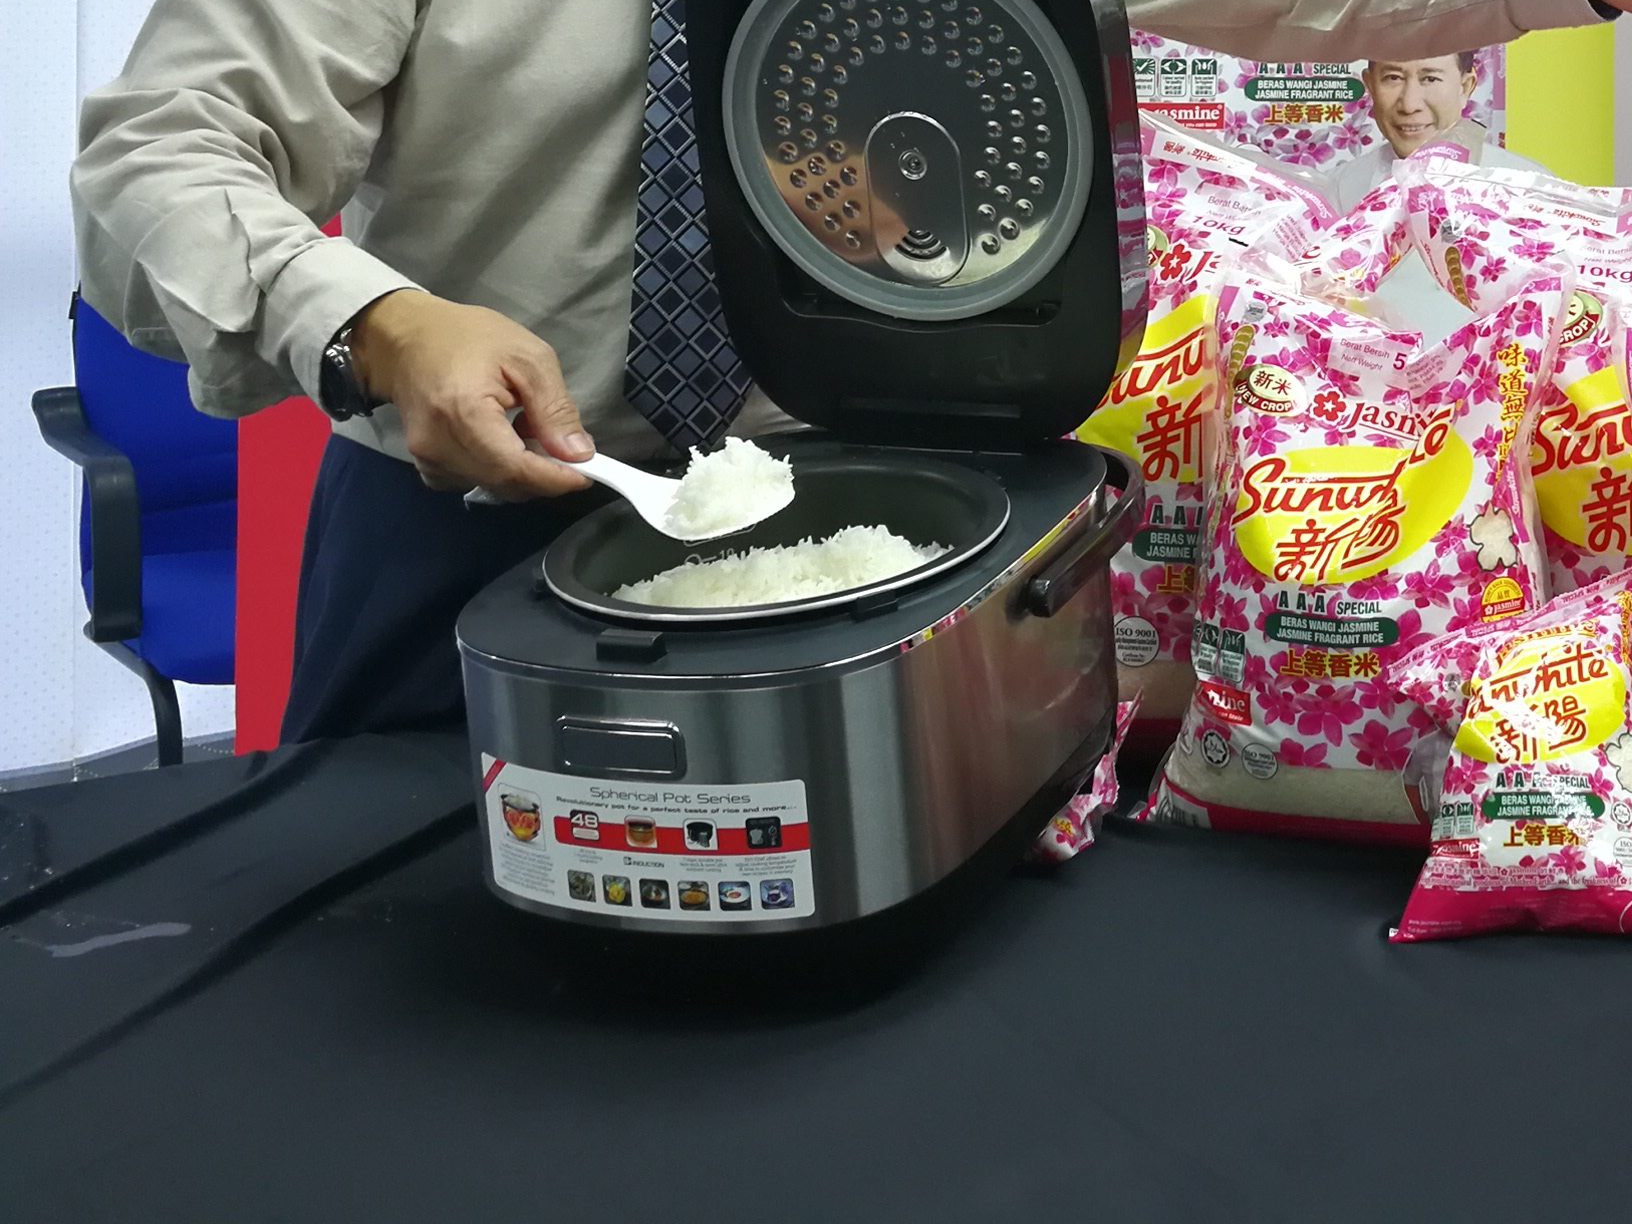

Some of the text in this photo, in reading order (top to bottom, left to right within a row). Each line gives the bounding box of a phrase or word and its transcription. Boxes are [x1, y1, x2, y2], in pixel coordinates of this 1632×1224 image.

[1313, 63, 1352, 75] SPECIAL
[1257, 80, 1348, 90] BERAS WANGI JASMINE
[1255, 90, 1354, 99] JASMINE FRAGRANT RICE
[1264, 103, 1344, 124] 上等香米
[1340, 339, 1390, 358] Berat Bersih
[1253, 369, 1292, 396] 新米
[1150, 532, 1184, 545] BERAS
[1147, 545, 1188, 558] JASMINE
[1336, 601, 1382, 615] SPECIAL
[1281, 616, 1379, 633] BERAS WANGI JASMINE
[1115, 627, 1157, 638] ISO 9001
[1276, 628, 1384, 644] JASMINE FRAGRANT RICE
[1280, 648, 1379, 678] 上等香米
[589, 786, 752, 805] Spherical Pot Series
[1501, 794, 1527, 805] BERAS
[556, 795, 609, 810] Revolutionary
[611, 803, 624, 811] pot
[627, 803, 640, 811] for
[650, 805, 681, 814] perfect
[1497, 805, 1531, 816] JASMINE
[570, 814, 598, 828] 48
[632, 860, 665, 868] INDUCTION
